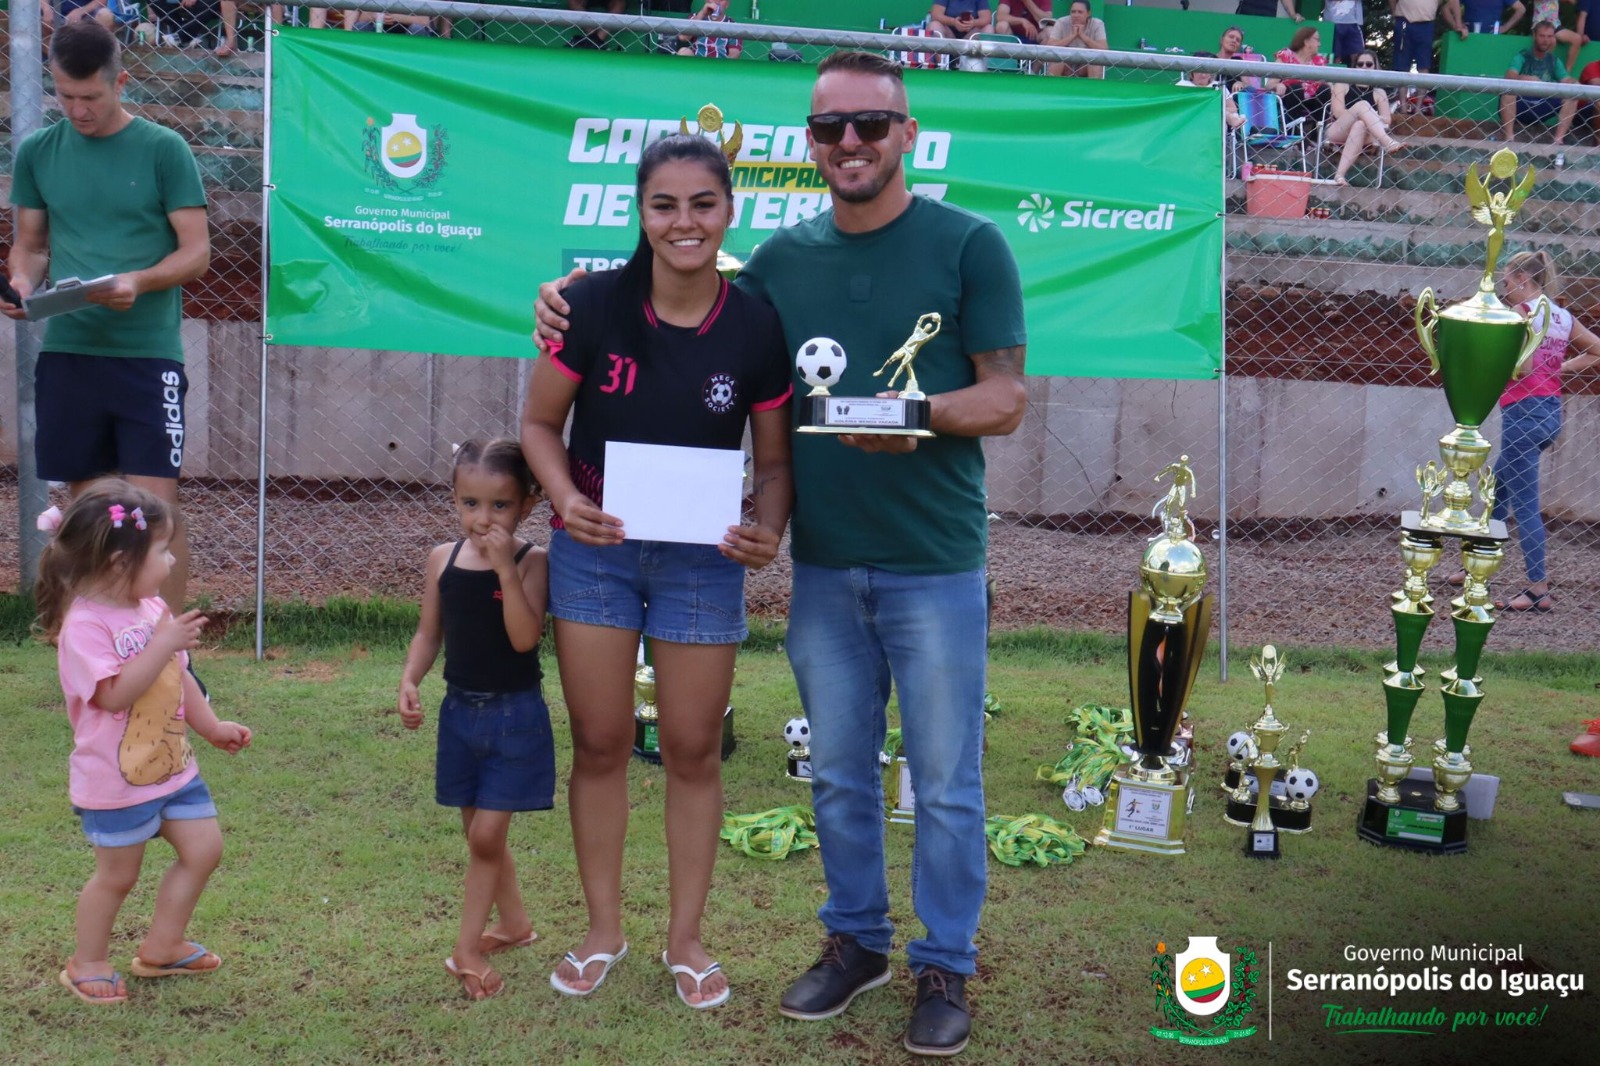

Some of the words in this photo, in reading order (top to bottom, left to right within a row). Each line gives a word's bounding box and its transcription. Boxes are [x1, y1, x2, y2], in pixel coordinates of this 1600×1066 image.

[355, 205, 398, 217] Governo
[401, 208, 450, 221] Municipal
[563, 183, 637, 227] DE
[1061, 200, 1176, 231] Sicredi
[324, 215, 413, 233] Serranópolis
[416, 221, 434, 234] do
[438, 223, 482, 240] Iguaçu
[343, 235, 409, 251] Trabalhando
[600, 353, 638, 396] 31
[710, 374, 735, 386] MEGA
[704, 397, 735, 412] SOCIETY
[161, 371, 184, 468] adidas
